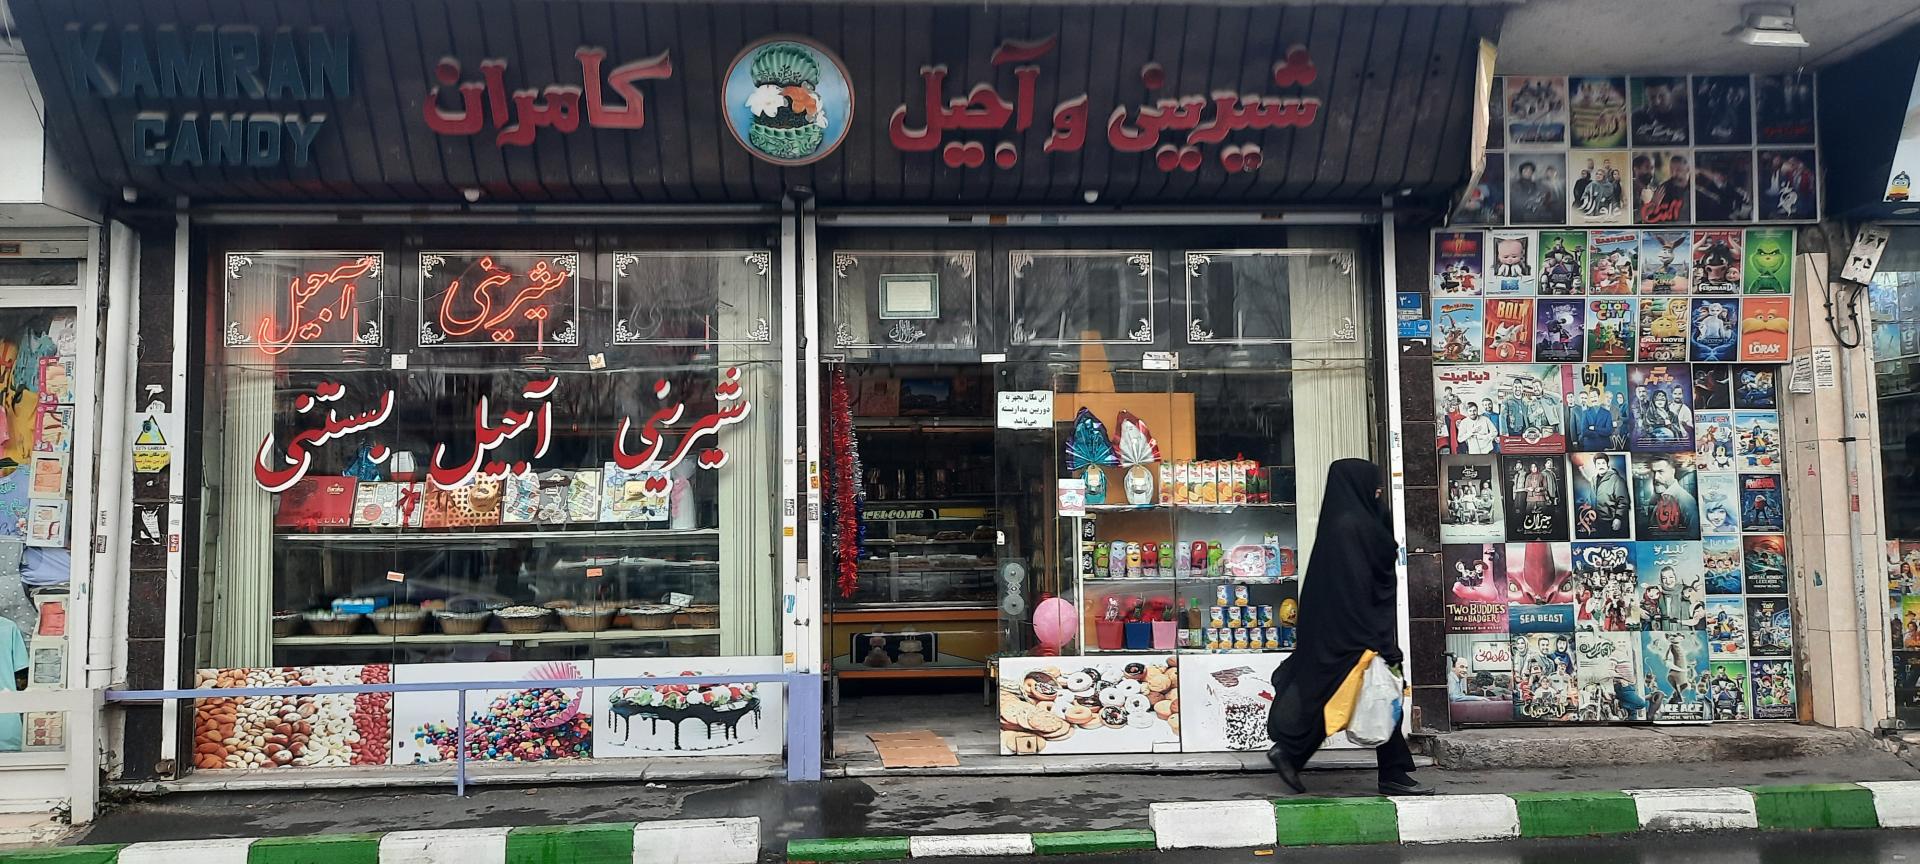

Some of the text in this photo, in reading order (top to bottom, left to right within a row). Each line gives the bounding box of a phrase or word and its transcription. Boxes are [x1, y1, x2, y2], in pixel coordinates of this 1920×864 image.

[65, 23, 350, 99] KAMRAN
[422, 36, 1321, 172] شیرینی و آجیل کامران
[133, 111, 328, 166] CANDY
[257, 255, 375, 355] آجیل
[440, 255, 569, 342] شیرینی
[1497, 301, 1529, 320] BOLT
[1748, 344, 1780, 354] LORAX
[1440, 370, 1490, 384] دینامیت
[1011, 394, 1023, 403] مجهز
[1025, 393, 1037, 403] مکان
[1038, 393, 1047, 403] این
[1029, 406, 1050, 415] دوربین
[254, 367, 752, 497] شیرینی آجیل بستنی
[863, 509, 924, 520] WELCOME
[1446, 603, 1506, 615] TWO BUDDIES
[1520, 613, 1564, 624] SEA BEAST
